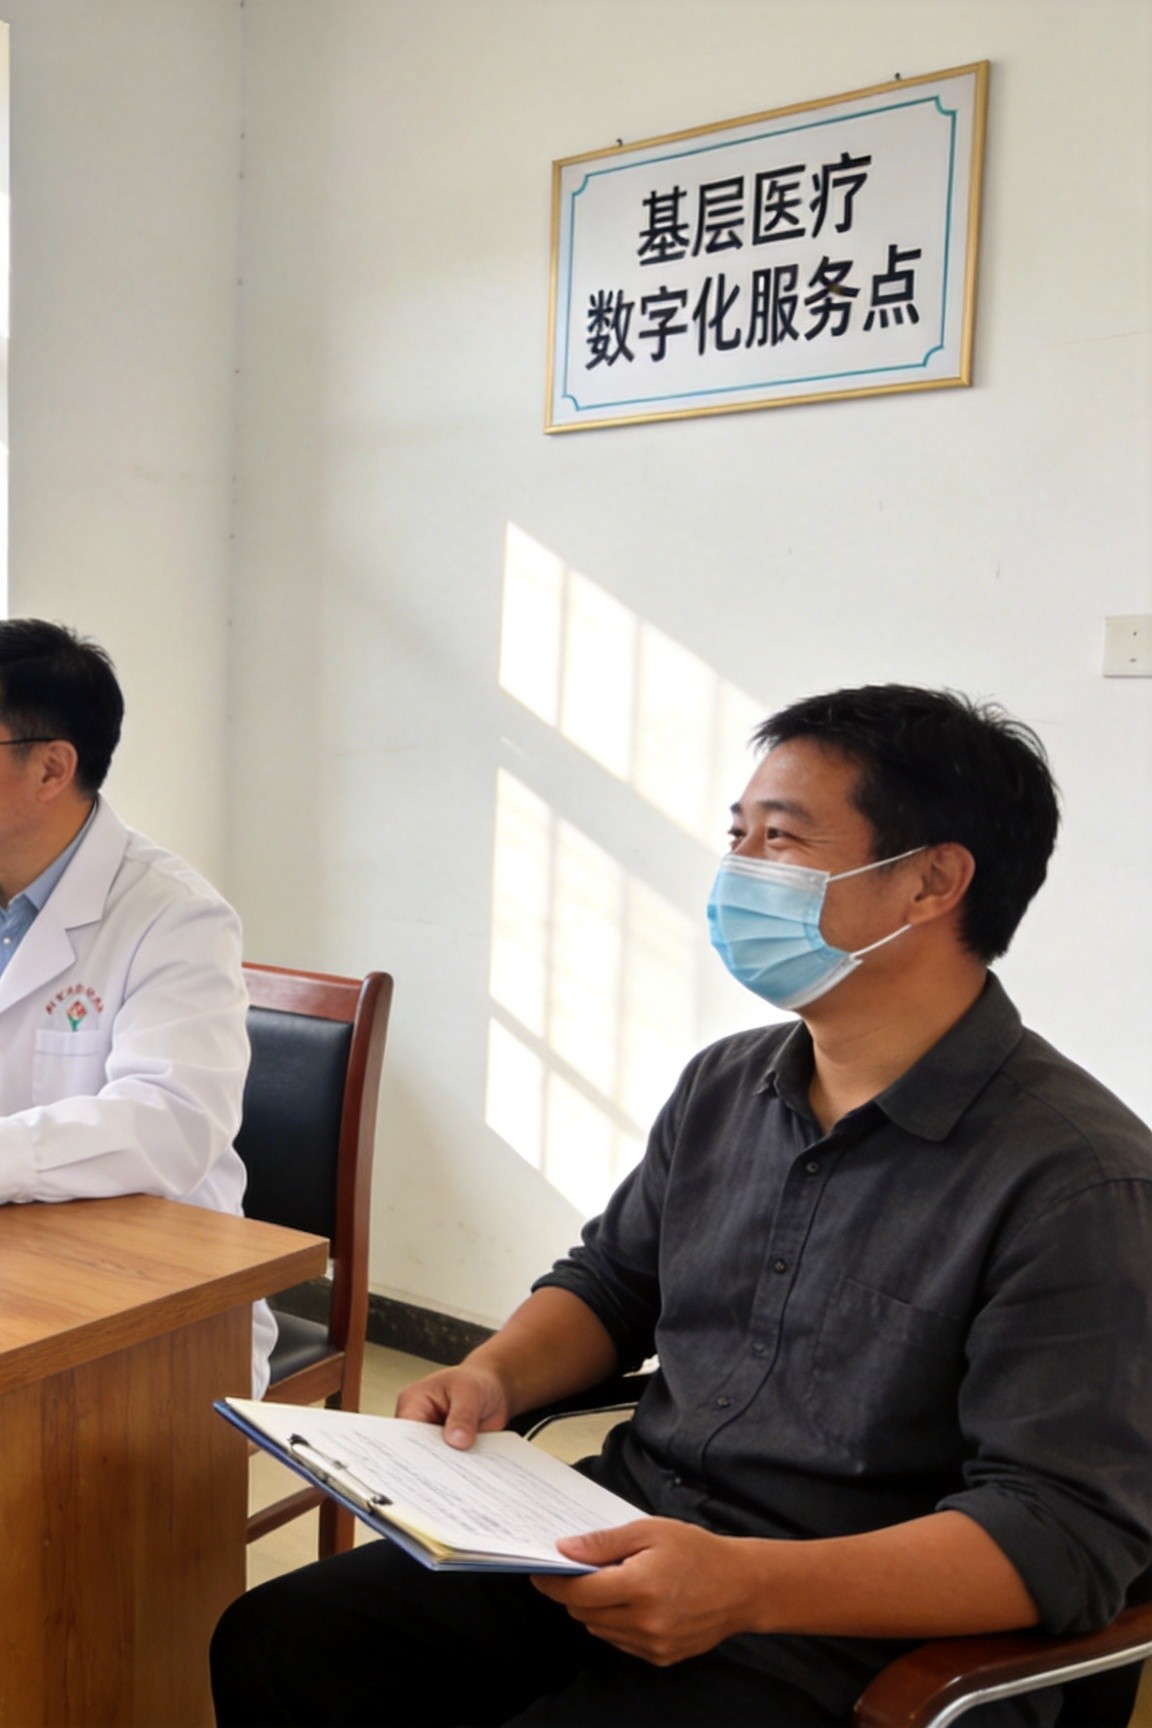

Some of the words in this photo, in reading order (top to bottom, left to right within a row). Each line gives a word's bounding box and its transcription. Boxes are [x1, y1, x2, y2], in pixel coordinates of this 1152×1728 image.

[637, 152, 872, 266] 基层医疗
[585, 244, 922, 370] 数字化服务点
